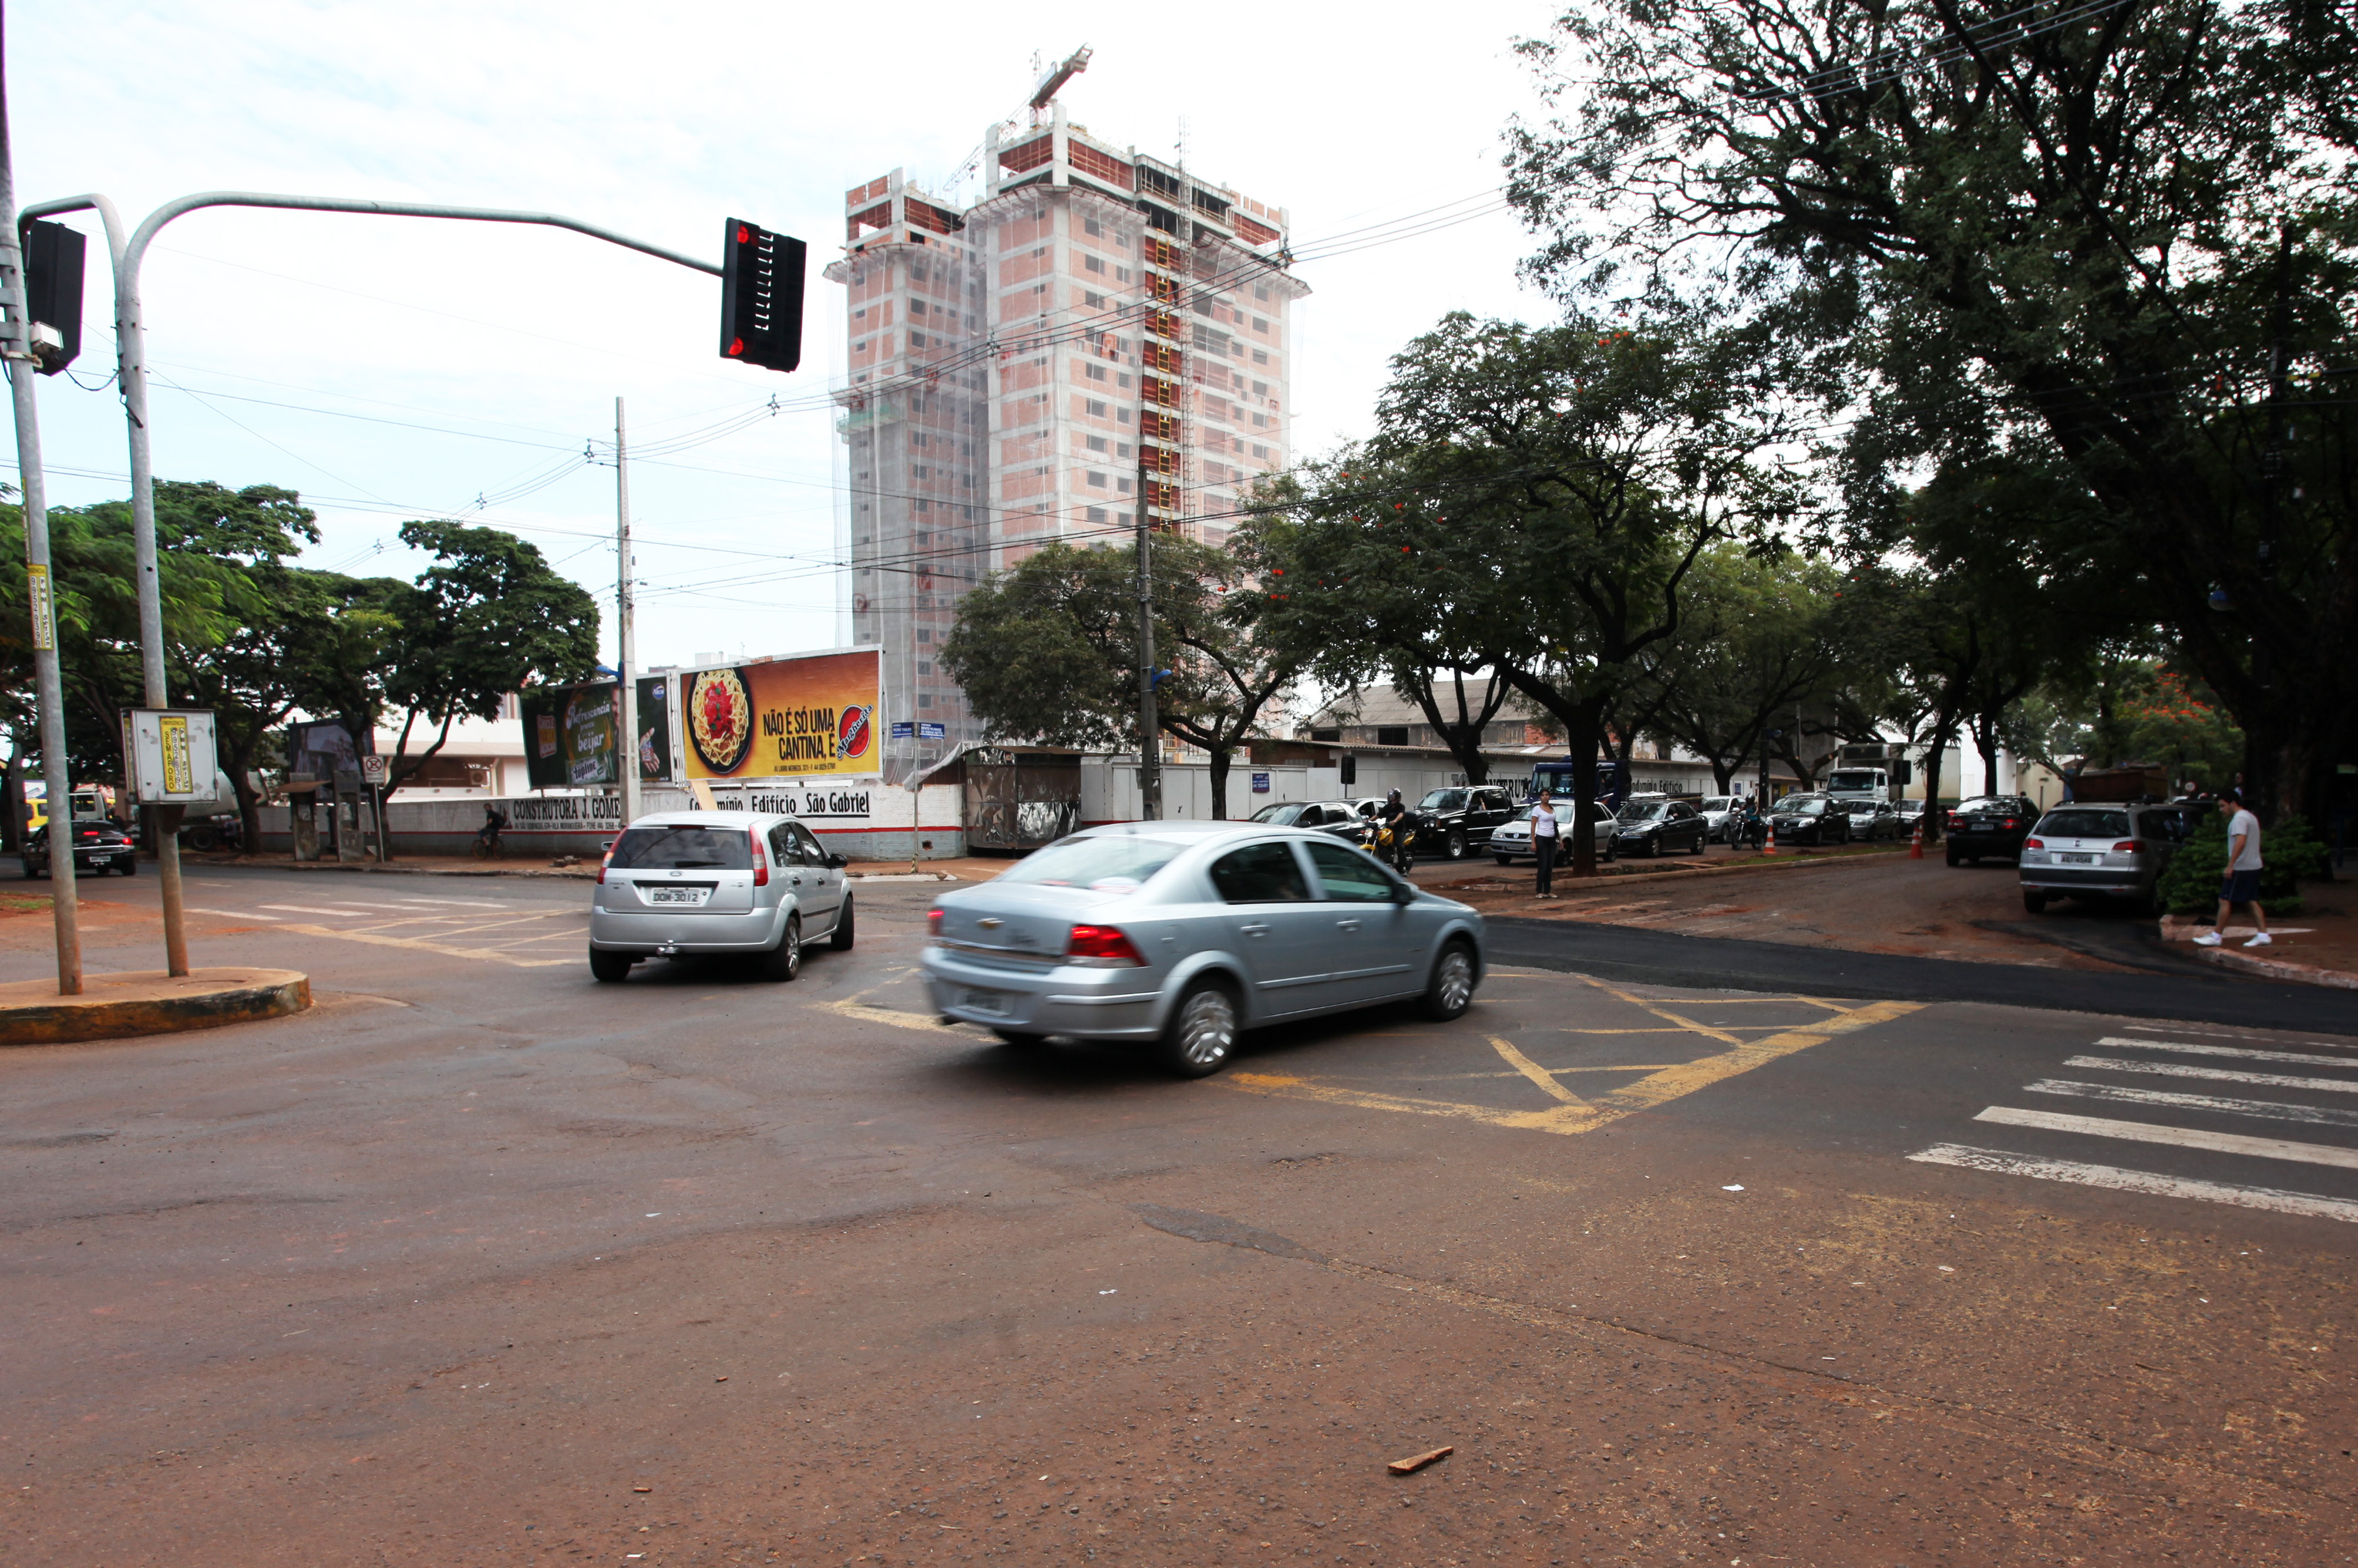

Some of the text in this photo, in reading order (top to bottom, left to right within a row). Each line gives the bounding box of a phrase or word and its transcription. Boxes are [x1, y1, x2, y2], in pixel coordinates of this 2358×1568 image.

[763, 706, 835, 736] NÃO É SÓ UMA
[837, 704, 873, 760] Margherita
[578, 732, 604, 755] beijar
[779, 728, 835, 760] CANTINA, É
[574, 760, 597, 779] topline
[1632, 780, 1657, 792] ndomínio
[514, 798, 620, 820] CONSTRUTORA J. GOME
[752, 795, 796, 814] Edifício
[806, 793, 825, 813] São
[829, 791, 870, 813] Gabriel
